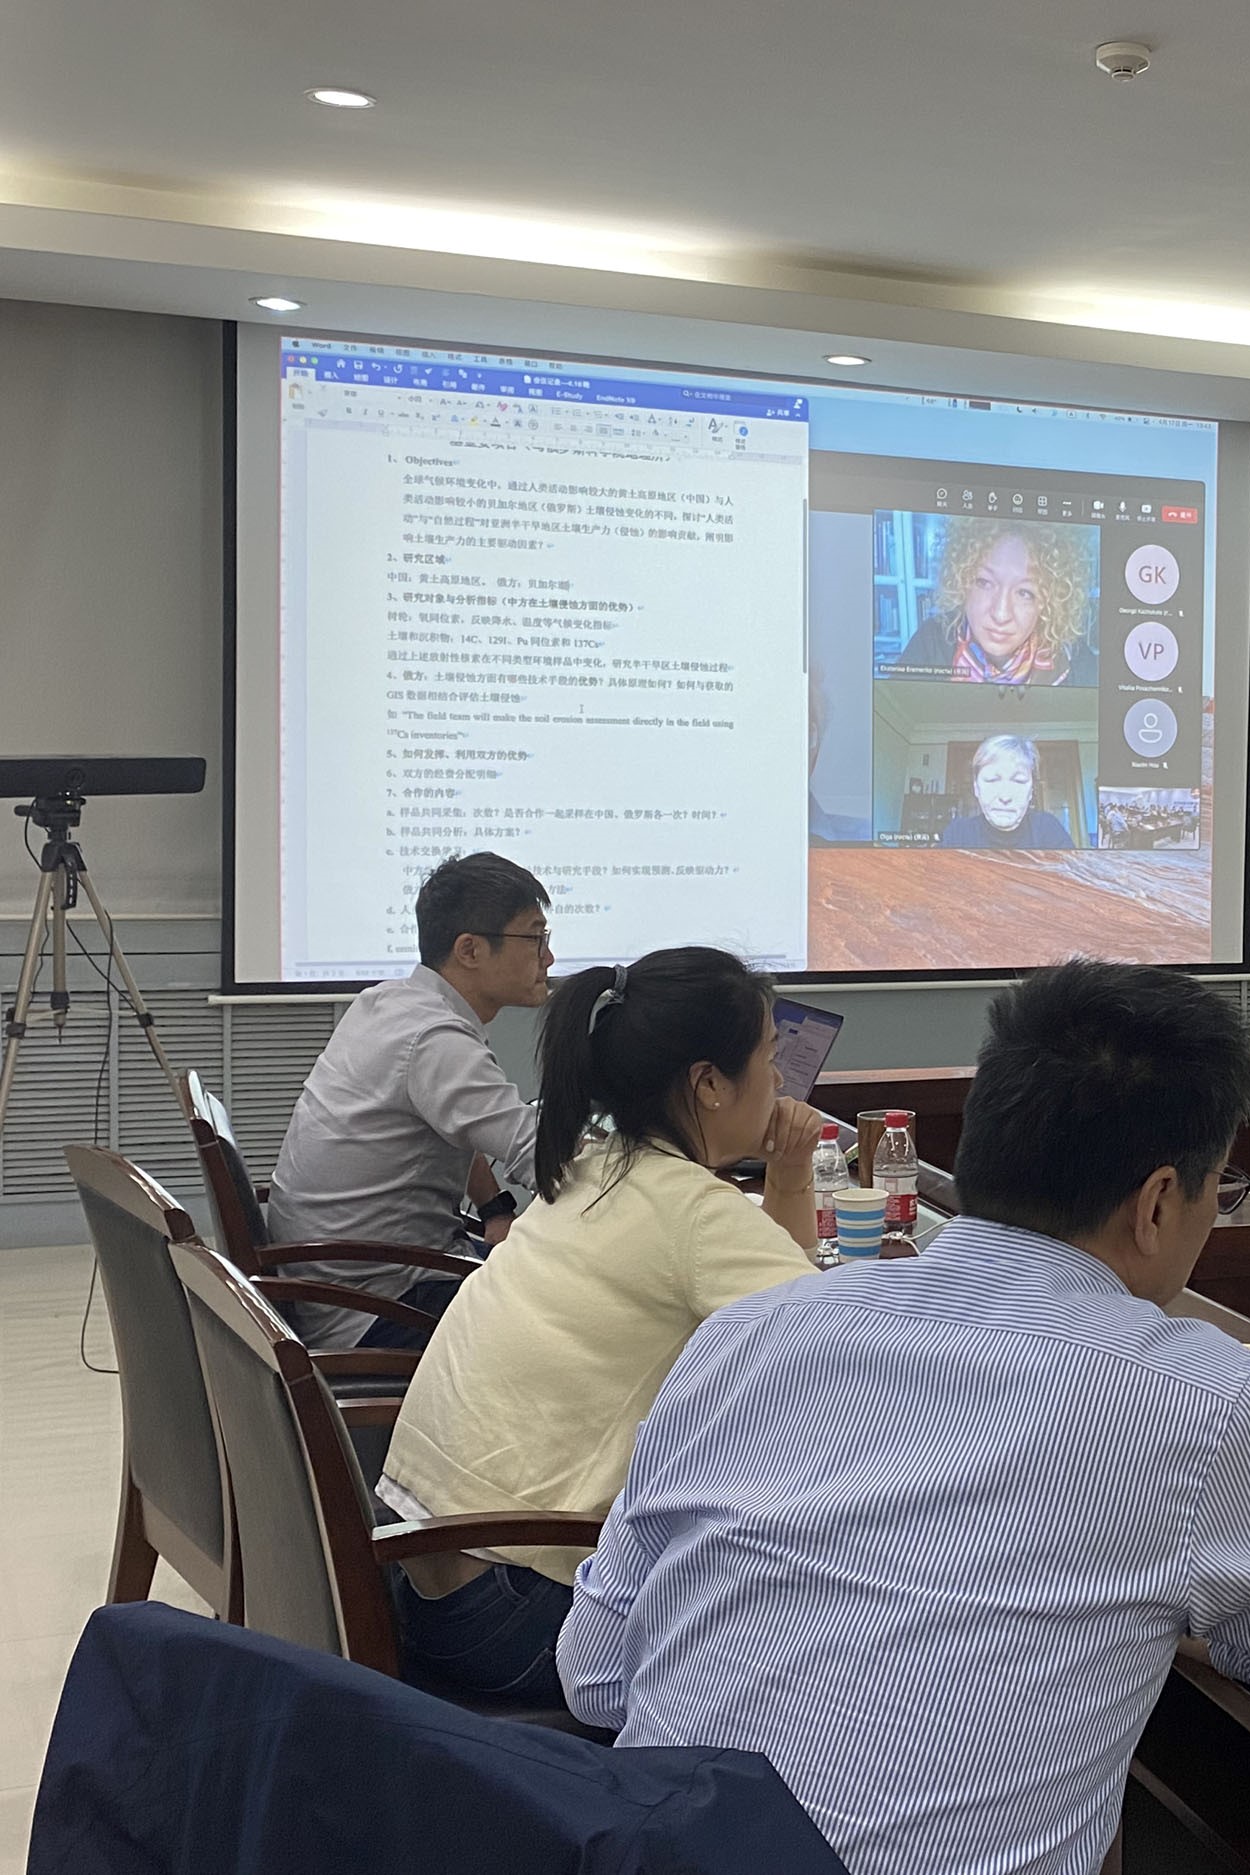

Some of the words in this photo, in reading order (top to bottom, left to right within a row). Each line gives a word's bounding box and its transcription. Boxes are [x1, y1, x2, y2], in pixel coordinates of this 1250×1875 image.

[312, 342, 331, 350] Word
[405, 455, 453, 467] Objectives
[1138, 564, 1166, 585] GK
[1138, 642, 1164, 660] VP
[427, 711, 447, 721] field
[450, 713, 470, 722] team
[474, 713, 490, 722] will
[493, 713, 516, 723] make
[519, 713, 532, 723] the
[535, 713, 550, 724] soil
[553, 715, 583, 724] erosion
[633, 716, 663, 728] directly
[666, 717, 674, 727] in
[677, 717, 689, 727] the
[692, 718, 710, 728] field
[713, 720, 734, 730] using
